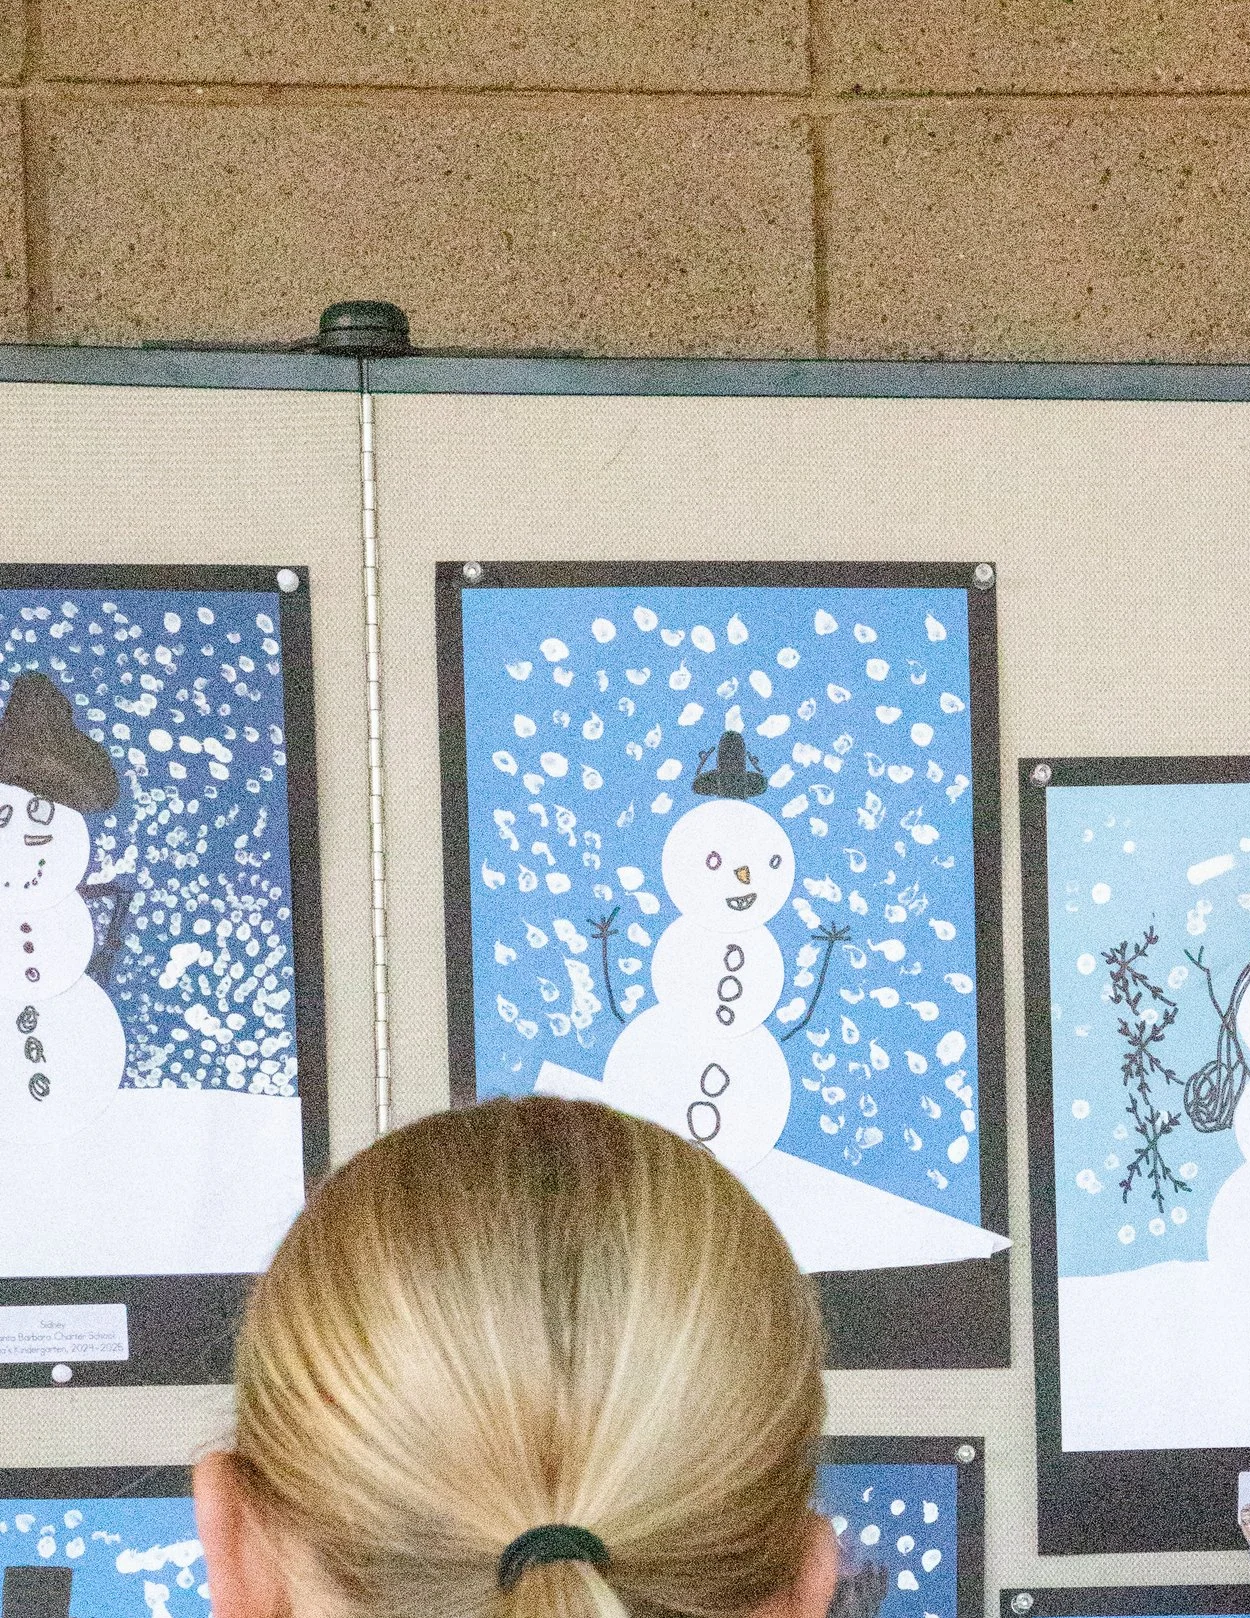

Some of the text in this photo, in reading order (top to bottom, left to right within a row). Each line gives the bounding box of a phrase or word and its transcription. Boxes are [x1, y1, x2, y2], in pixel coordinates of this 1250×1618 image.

[18, 1332, 52, 1342] Barbara
[53, 1331, 86, 1341] Charter
[88, 1331, 116, 1341] School
[14, 1345, 69, 1357] Kindergarten,
[71, 1343, 125, 1353] 2024-2025
